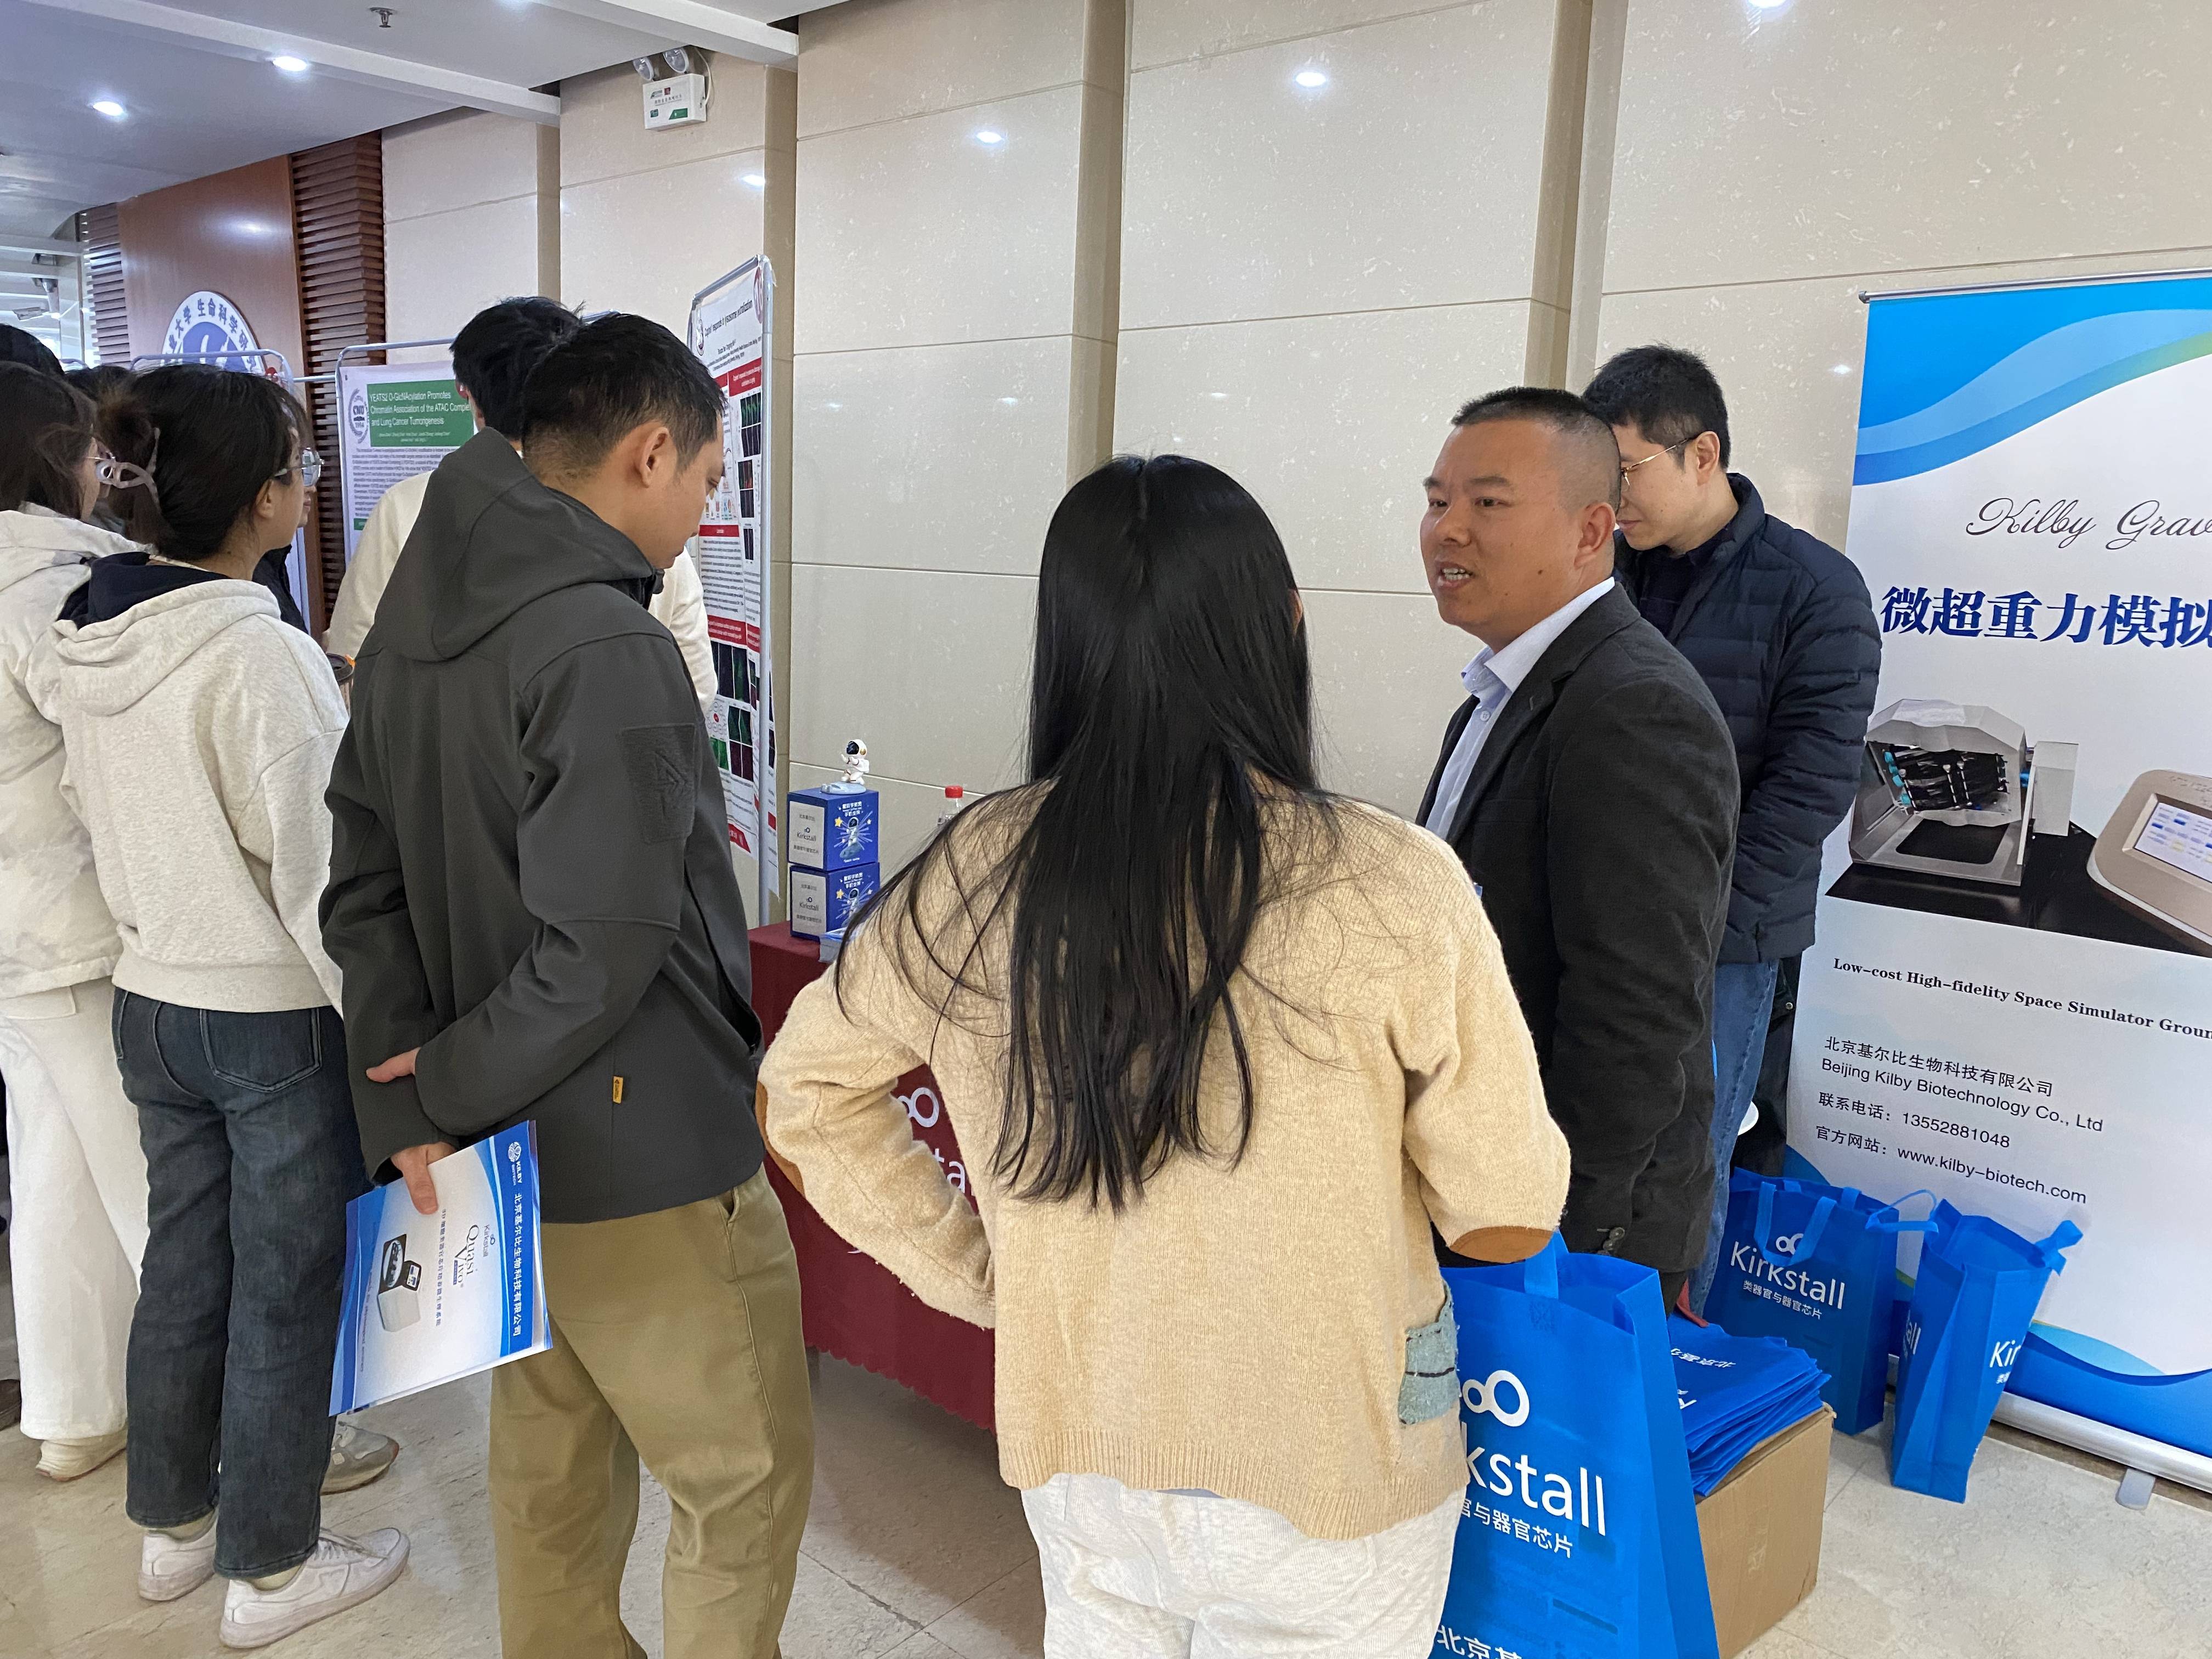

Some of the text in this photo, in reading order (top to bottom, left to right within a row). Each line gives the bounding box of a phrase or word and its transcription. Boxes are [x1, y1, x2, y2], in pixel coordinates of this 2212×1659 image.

[420, 404, 426, 413] of
[435, 403, 449, 411] ATAC
[449, 402, 471, 412] Comple
[427, 391, 451, 399] Promotes
[1966, 497, 2097, 549] Kilby
[1880, 586, 2212, 648] 微超重力模拟
[797, 832, 816, 842] Kirkstall
[1833, 957, 1903, 981] Low-cost
[1906, 971, 2011, 1002] High-fidelity
[2014, 991, 2062, 1011] Space
[2068, 1001, 2154, 1028] Simulator
[1824, 1036, 2053, 1097] 北京基尔比生物科技有限公司
[1822, 1058, 2103, 1132] Beijing Kilby Biotechnology Co., Ltd
[1903, 1113, 2010, 1148] 13552881048
[1898, 1148, 2086, 1204] www.kilby-biotech.com
[466, 1224, 479, 1275] Quasi
[513, 1193, 523, 1337] 北京基尔比生物科技有限公司
[1730, 1241, 1845, 1310] Kirkstall
[1743, 1279, 1822, 1320] 类器官与器官芯片
